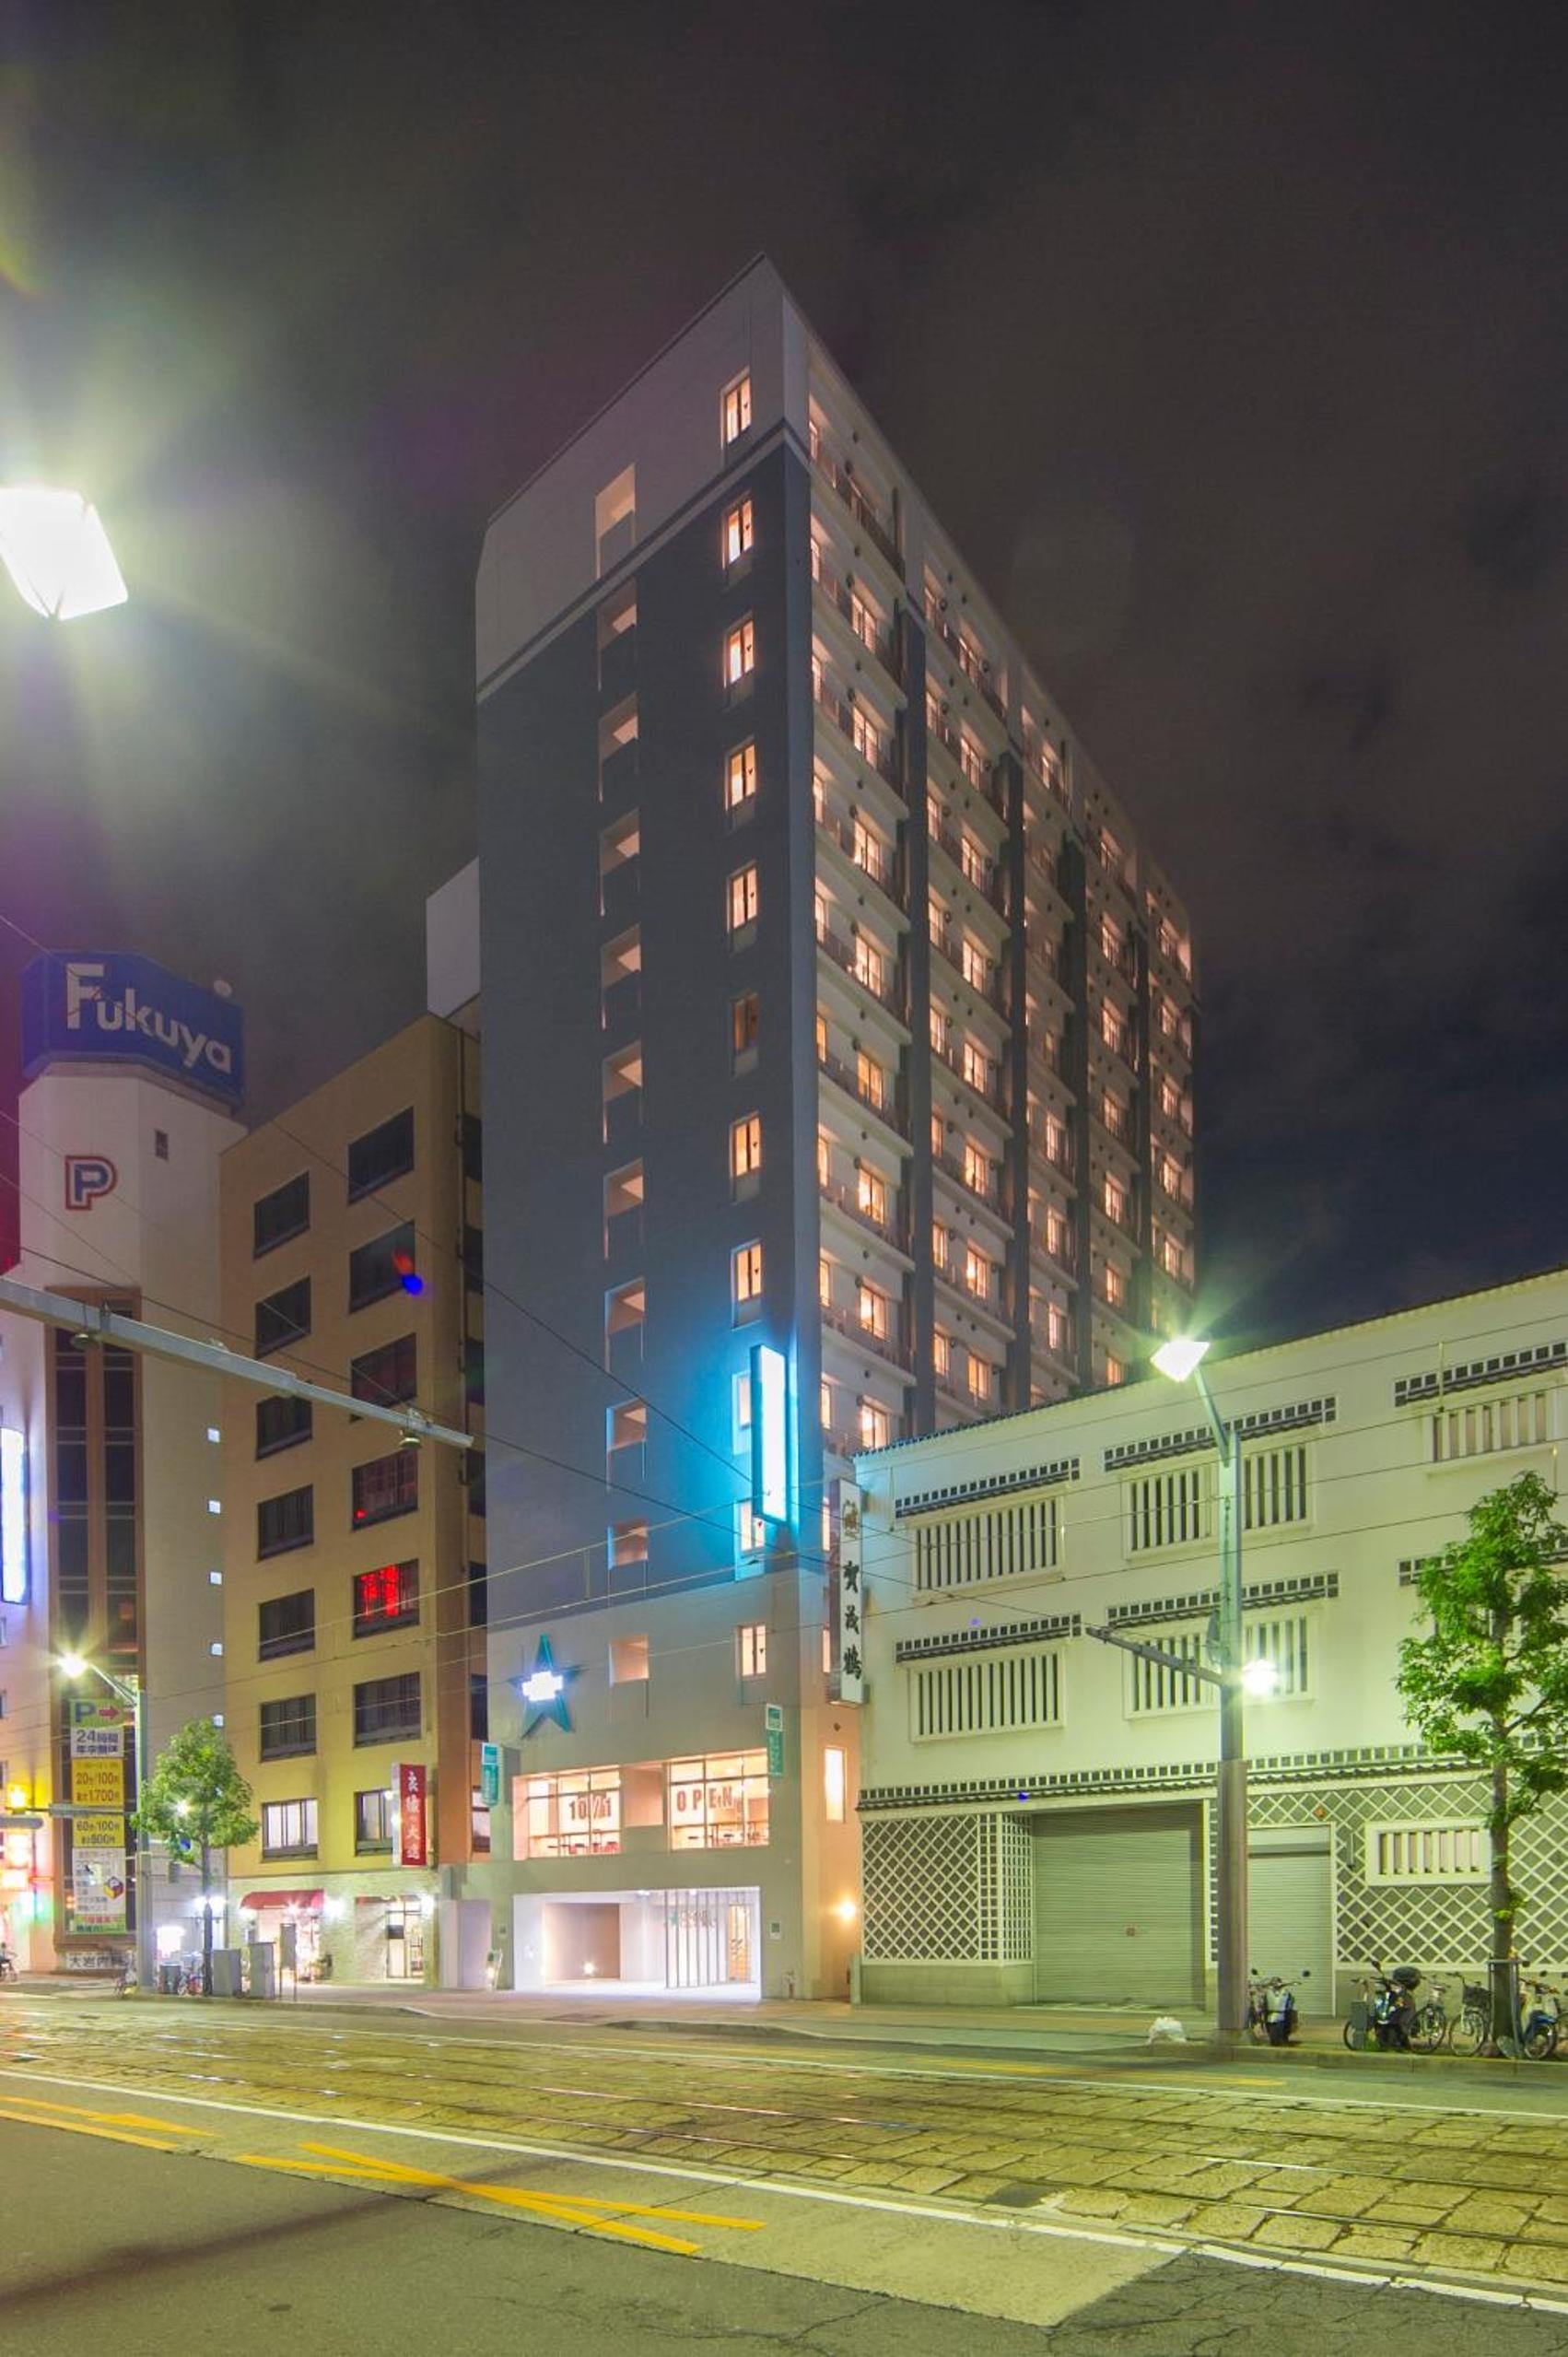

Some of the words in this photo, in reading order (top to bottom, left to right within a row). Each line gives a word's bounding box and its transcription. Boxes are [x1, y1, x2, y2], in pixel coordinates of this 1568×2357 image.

[65, 963, 231, 1074] Fukuya
[65, 1155, 118, 1211] P
[842, 1560, 862, 1679] 賀茂鶴
[75, 1702, 96, 1723] P
[676, 1785, 733, 1812] OPEN
